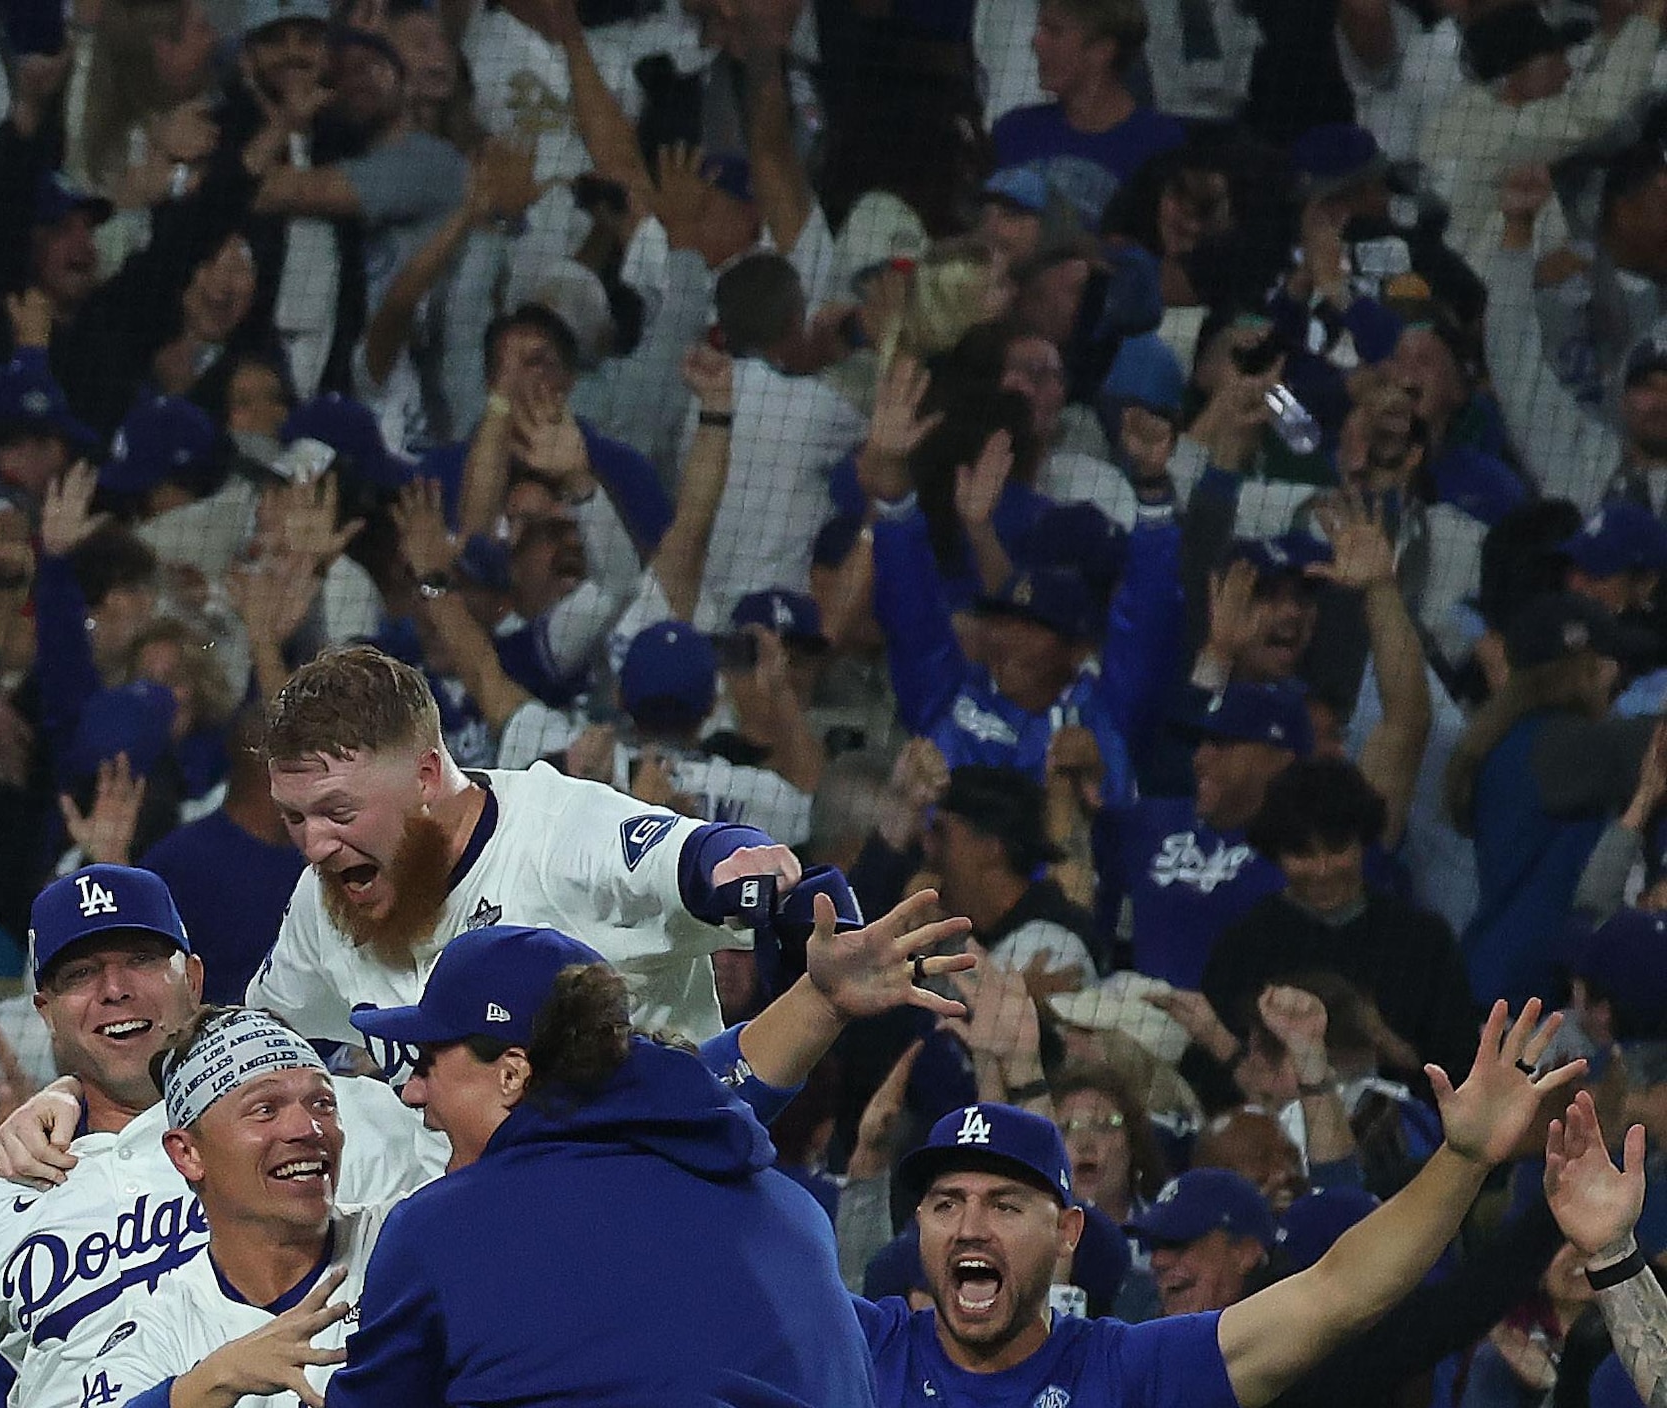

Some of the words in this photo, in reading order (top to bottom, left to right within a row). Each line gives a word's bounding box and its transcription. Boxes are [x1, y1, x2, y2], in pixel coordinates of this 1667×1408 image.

[75, 875, 118, 917] LA
[264, 1038, 292, 1049] LOS
[211, 1070, 236, 1094] LOS
[238, 1050, 299, 1077] ANGELES
[957, 1105, 992, 1145] LA
